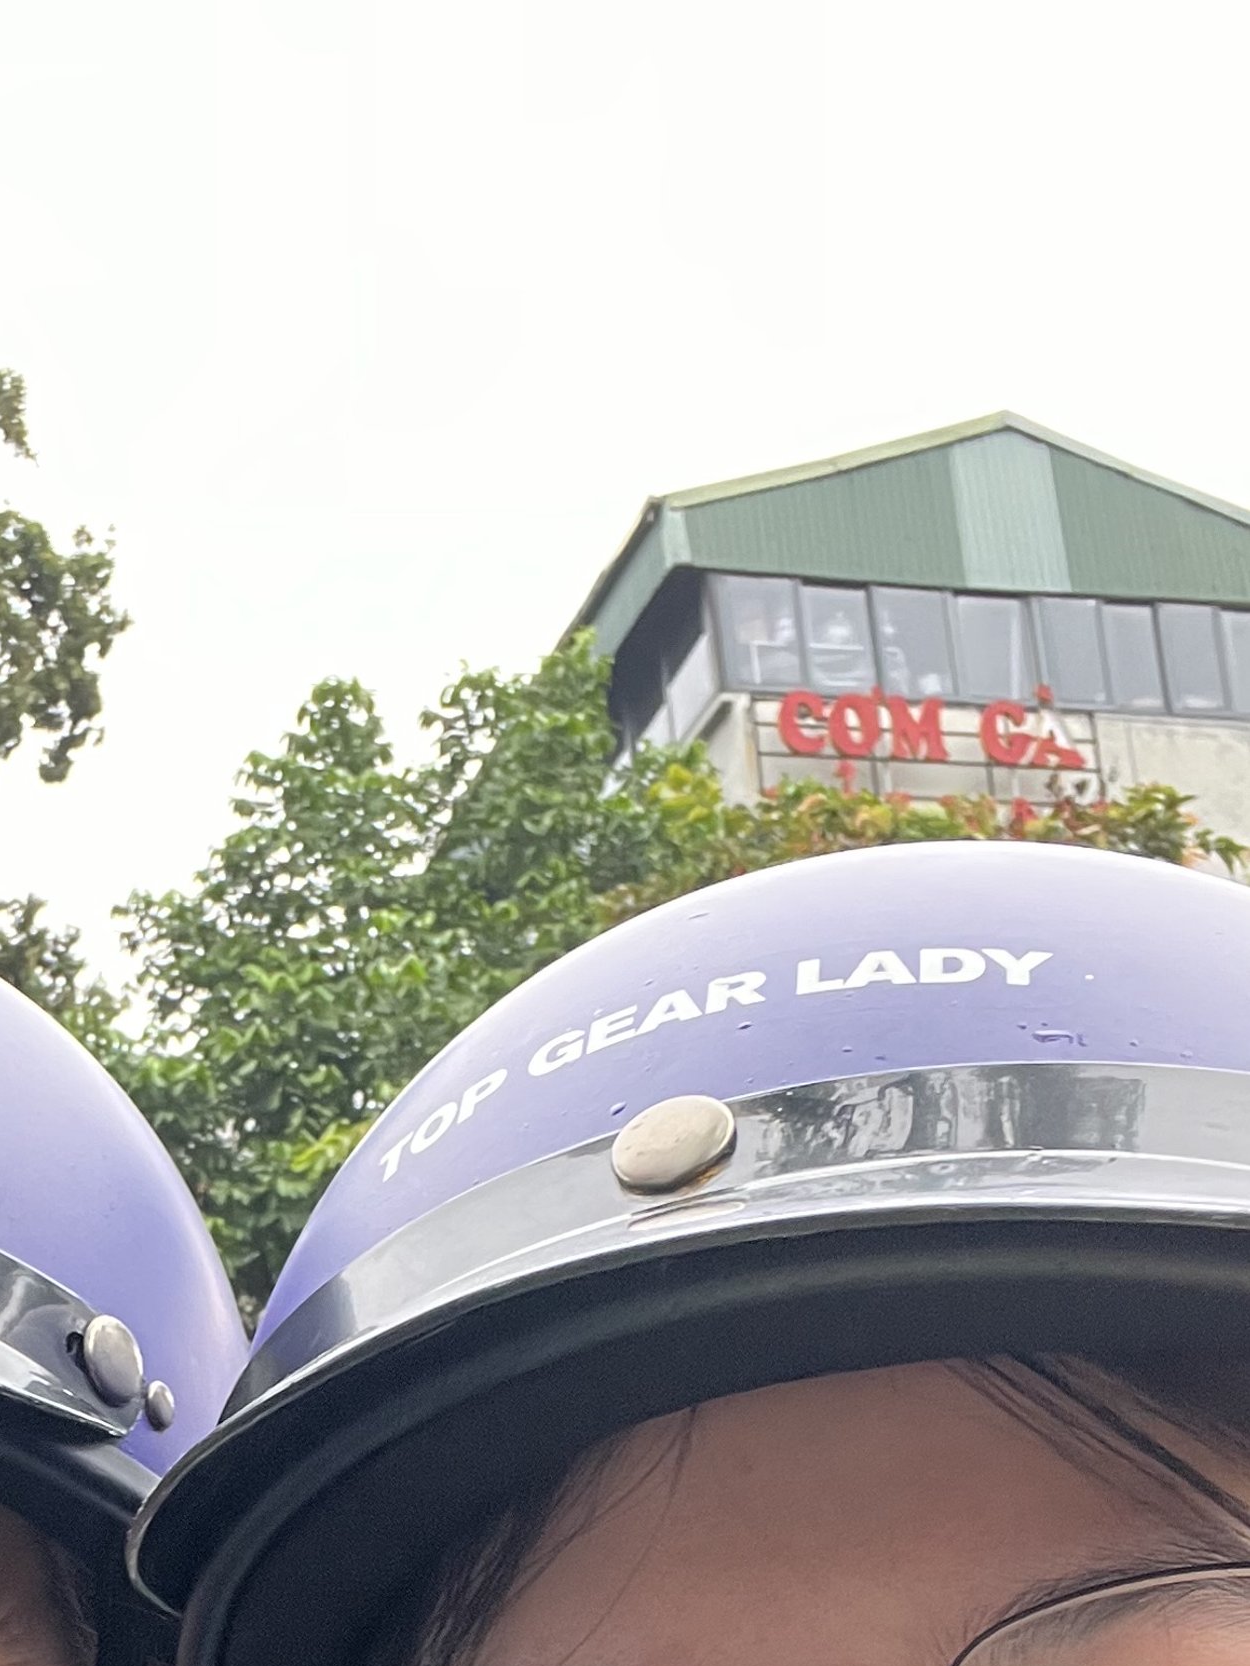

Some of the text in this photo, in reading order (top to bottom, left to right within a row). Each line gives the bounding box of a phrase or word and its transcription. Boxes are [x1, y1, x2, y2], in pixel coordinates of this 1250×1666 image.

[379, 948, 1053, 1182] TOP GEAR LADY
